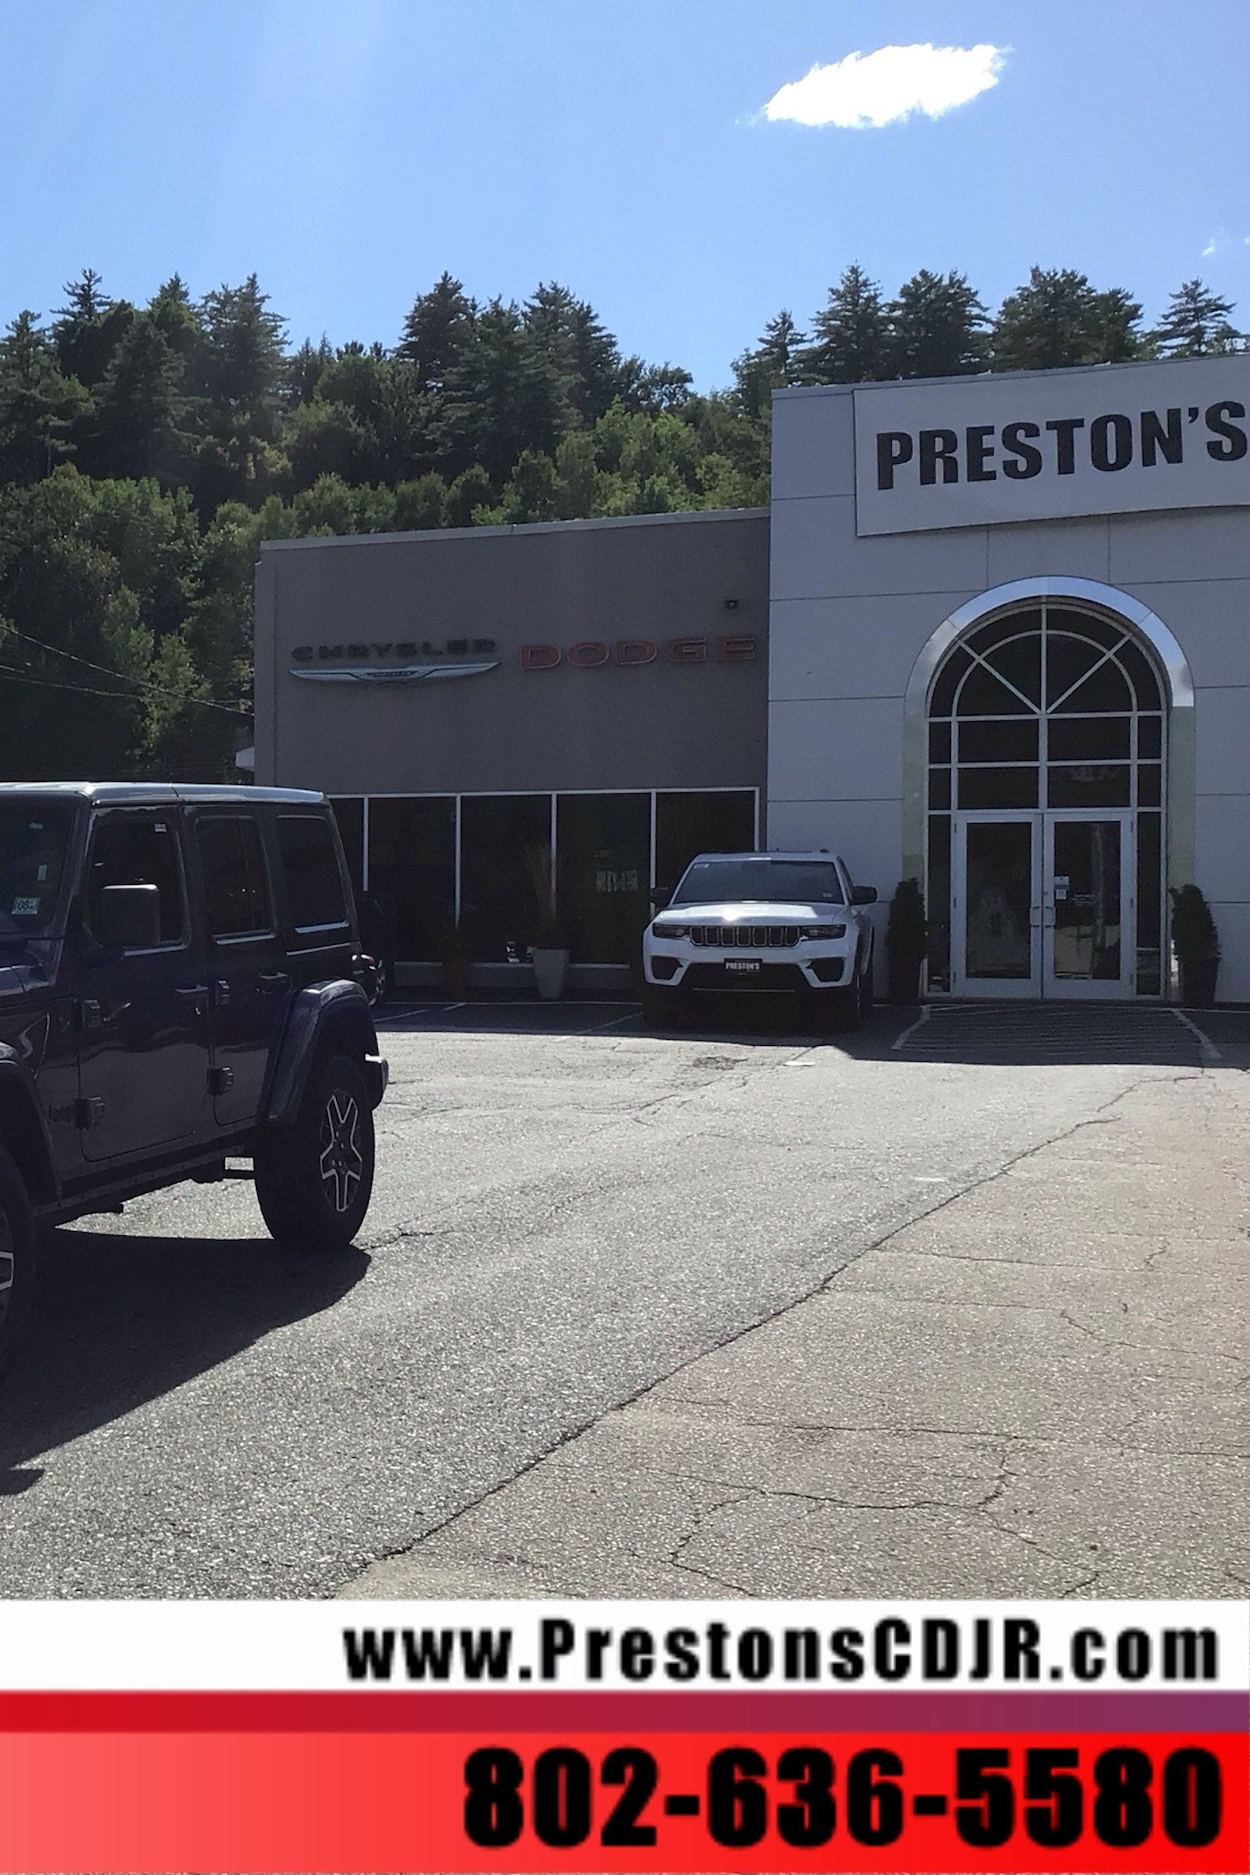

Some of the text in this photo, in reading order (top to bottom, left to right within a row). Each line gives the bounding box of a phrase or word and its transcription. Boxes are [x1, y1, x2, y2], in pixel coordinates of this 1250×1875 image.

[877, 401, 1247, 490] PRESTON'S
[291, 637, 498, 662] CHRYSLER
[520, 636, 757, 670] DODGE
